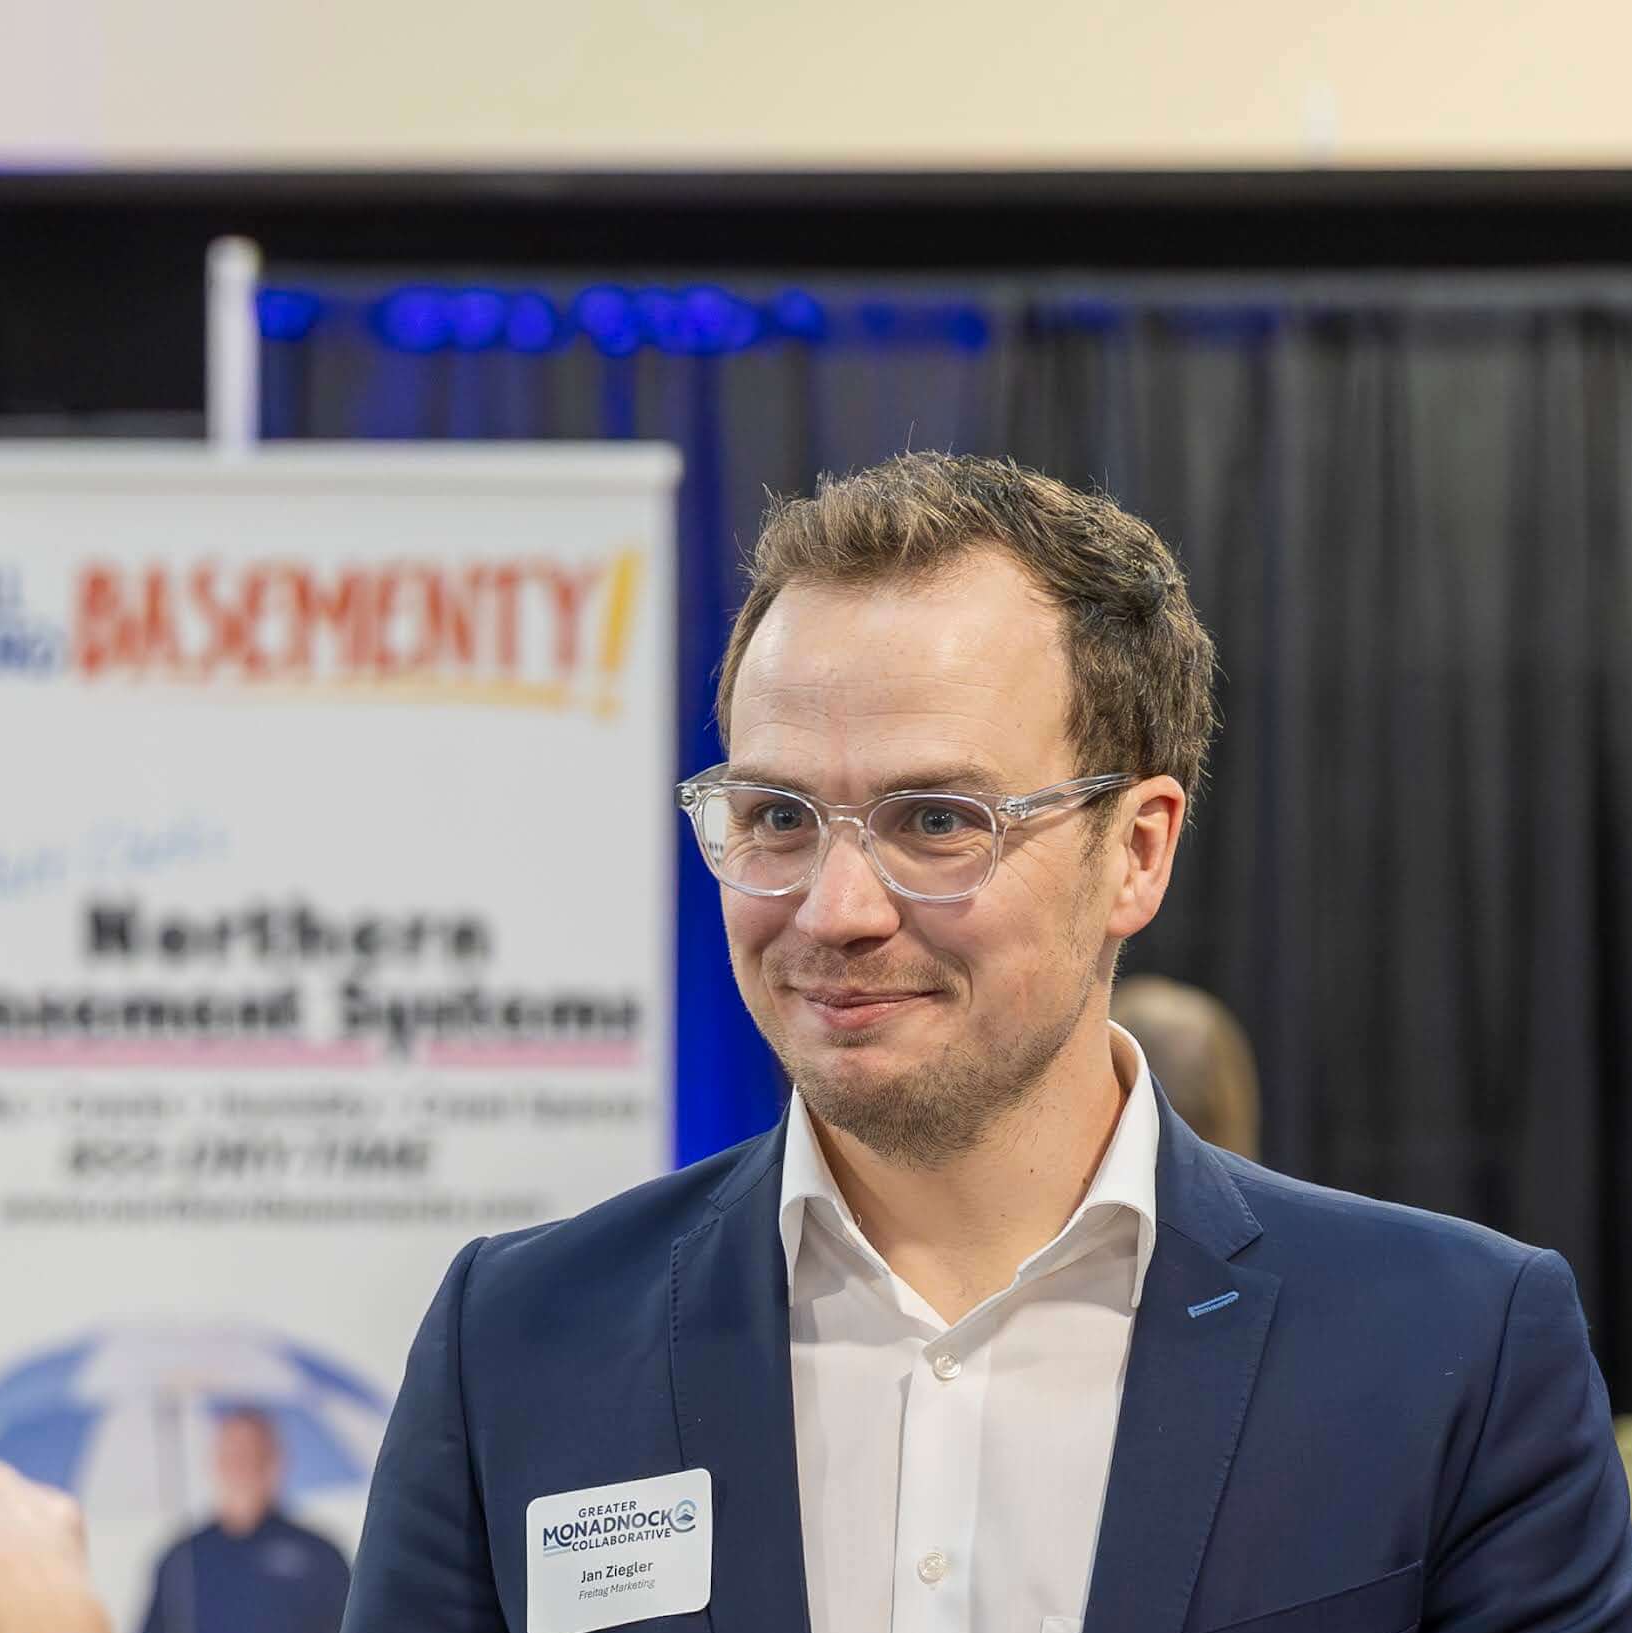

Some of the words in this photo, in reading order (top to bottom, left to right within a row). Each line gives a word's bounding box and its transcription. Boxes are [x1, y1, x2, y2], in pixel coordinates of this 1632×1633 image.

[578, 1500, 637, 1518] GREATER
[543, 1508, 675, 1547] MONADNOCK
[572, 1528, 671, 1551] COLLABORATIVE
[581, 1569, 602, 1583] Jan
[606, 1561, 654, 1578] Ziegler
[578, 1586, 608, 1600] Freitag
[610, 1578, 655, 1594] Marketing
